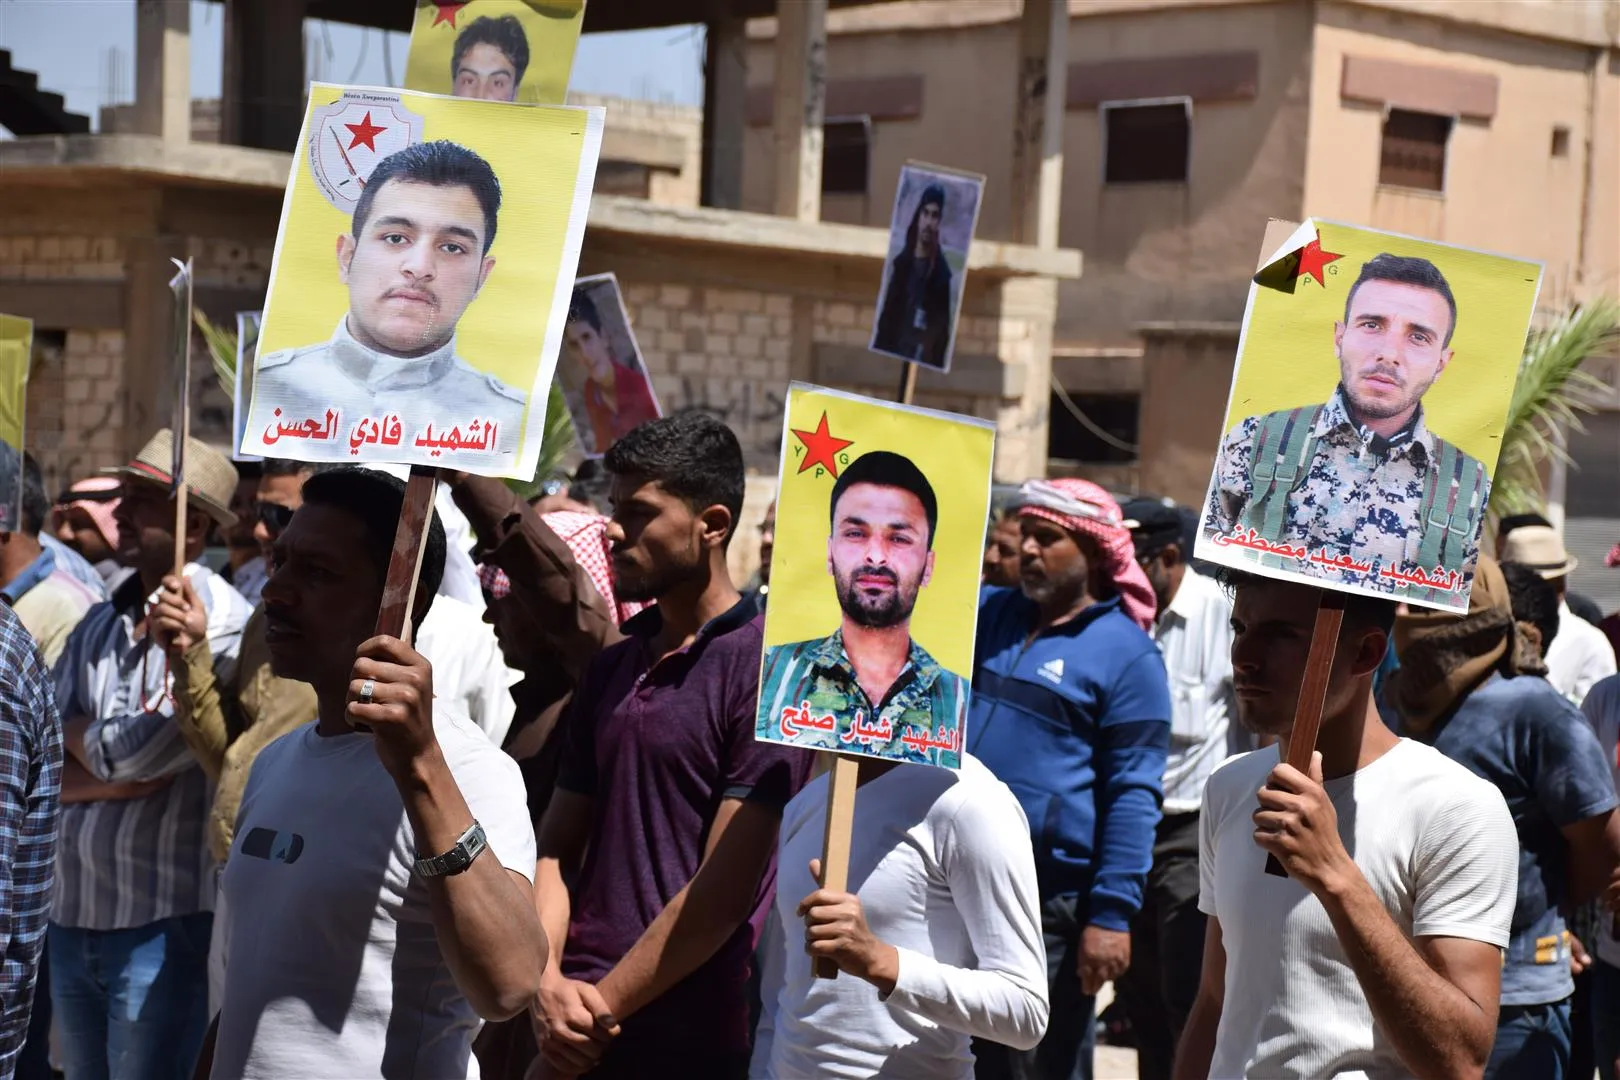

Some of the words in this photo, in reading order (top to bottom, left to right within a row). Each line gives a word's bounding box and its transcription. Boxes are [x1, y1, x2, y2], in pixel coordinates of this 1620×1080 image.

[263, 407, 339, 445] الحسن
[350, 414, 402, 456] فادي
[414, 419, 498, 457] الشهيد
[1213, 524, 1307, 560] مصطفى
[1310, 549, 1371, 573] سعيد
[1380, 562, 1464, 591] الشهيد
[841, 713, 892, 742] شيار
[901, 726, 960, 752] الشهيد
